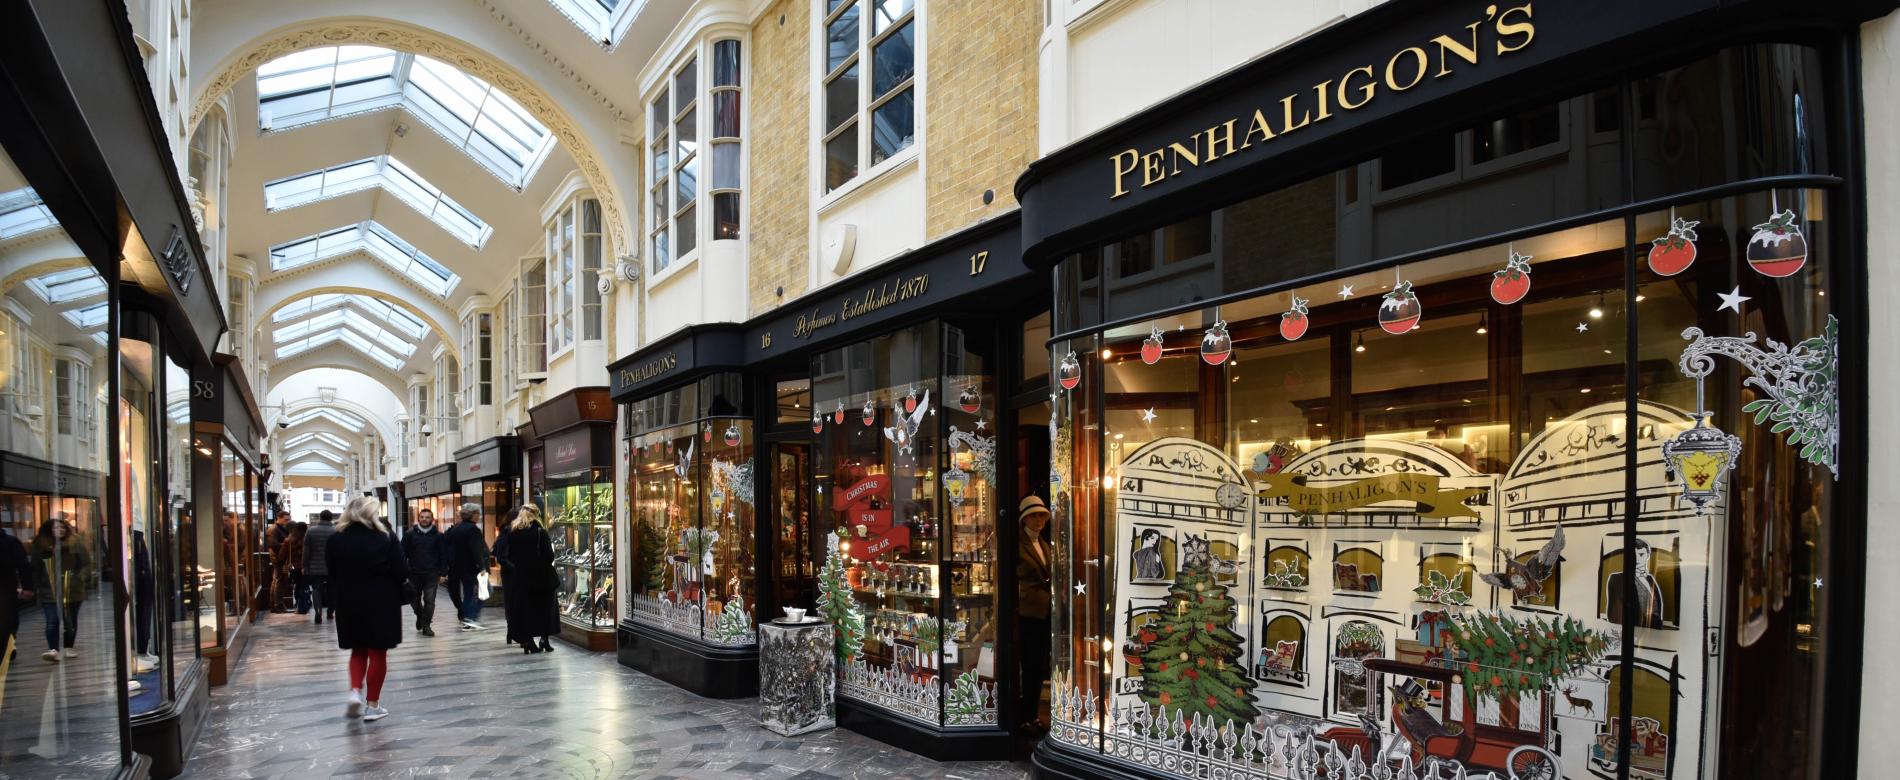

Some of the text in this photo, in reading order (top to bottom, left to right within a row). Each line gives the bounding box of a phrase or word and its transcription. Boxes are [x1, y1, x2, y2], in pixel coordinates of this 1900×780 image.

[1109, 3, 1536, 200] PENHALIGON'S
[969, 251, 989, 276] 17
[793, 273, 929, 338] Perfumers Established 1870
[761, 332, 771, 349] 16
[620, 351, 677, 388] PENHALIGON'S
[194, 380, 214, 399] 58
[588, 401, 597, 410] 15
[846, 481, 877, 500] CHRISTMAS
[1299, 480, 1427, 505] PENHALIGON'S
[868, 514, 875, 522] IN
[868, 538, 890, 554] THE AIR
